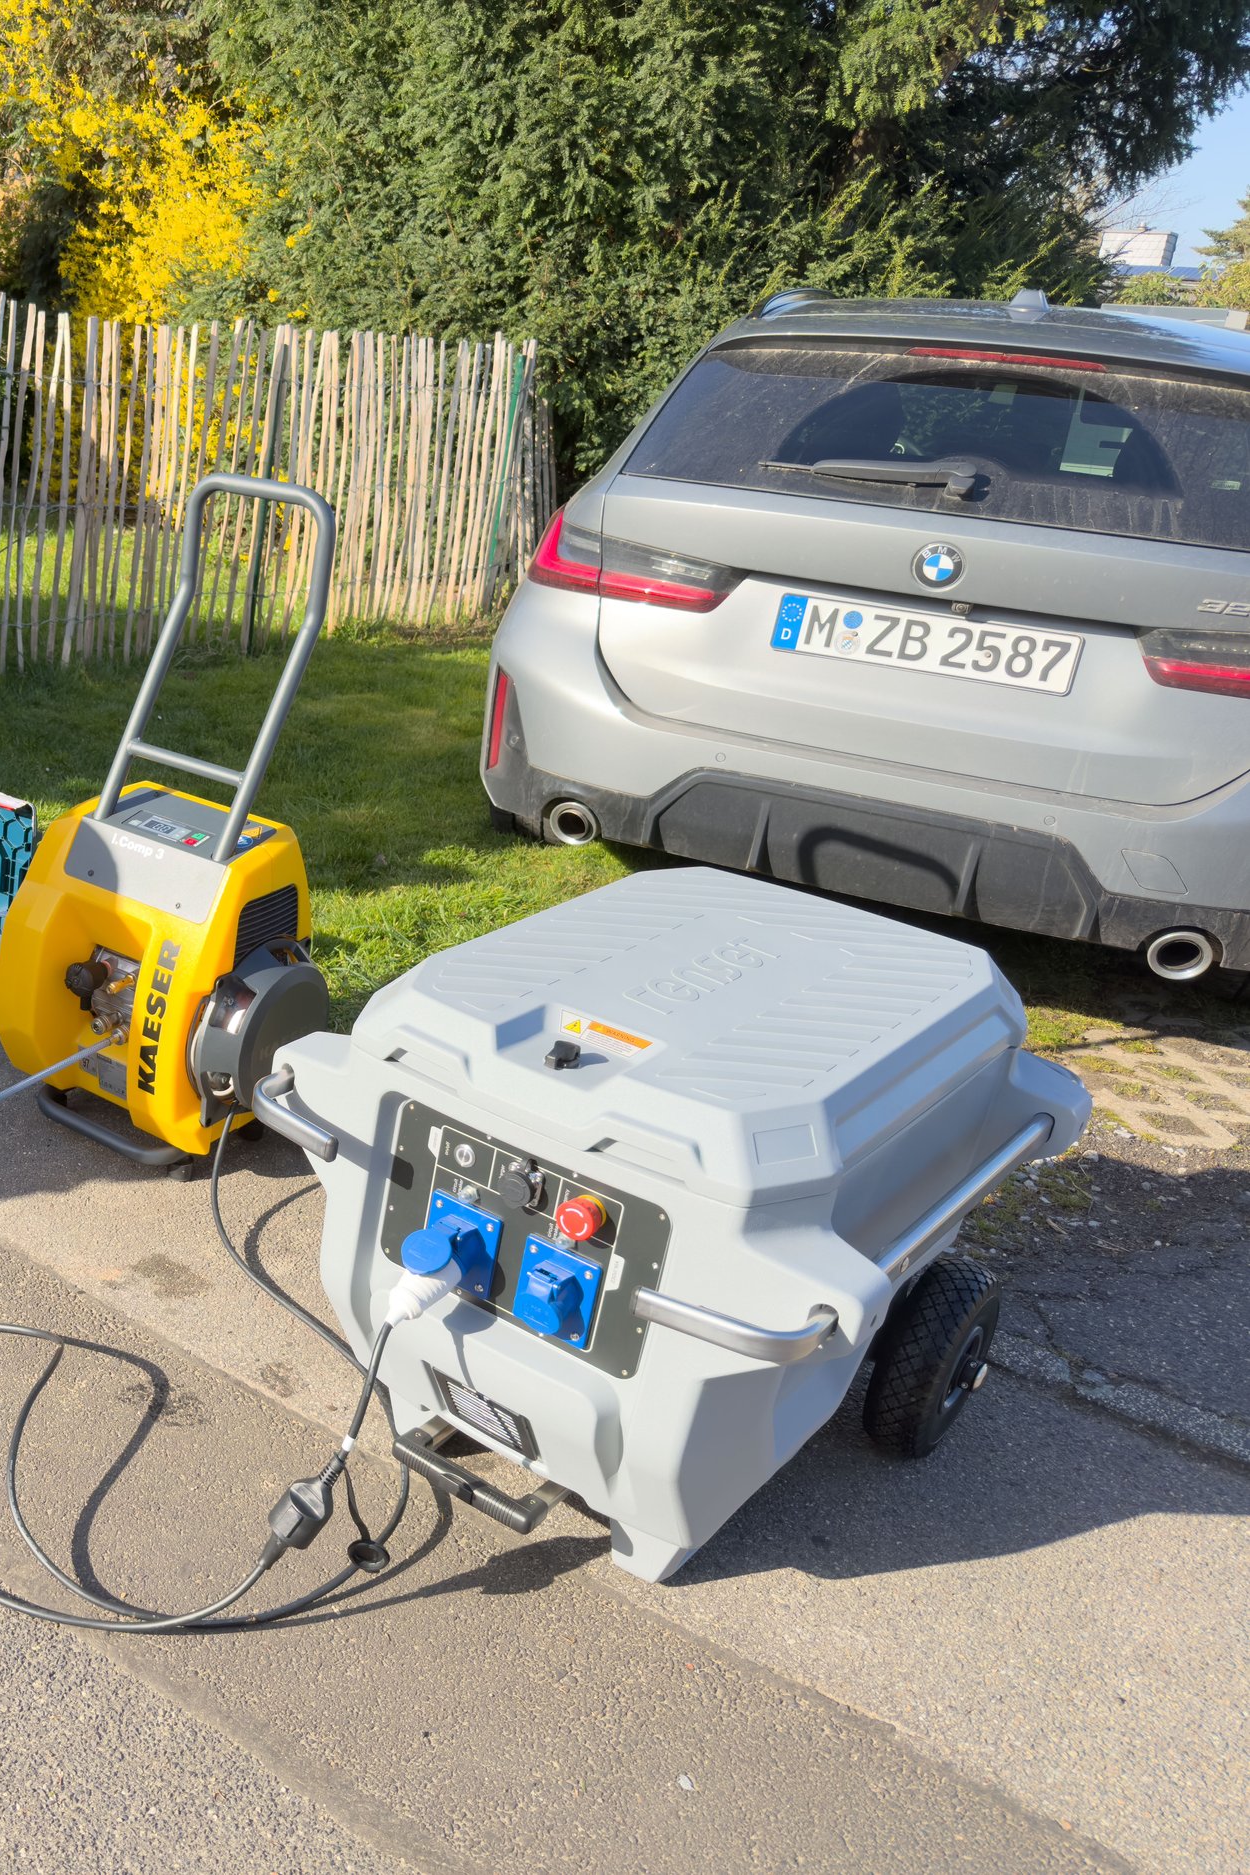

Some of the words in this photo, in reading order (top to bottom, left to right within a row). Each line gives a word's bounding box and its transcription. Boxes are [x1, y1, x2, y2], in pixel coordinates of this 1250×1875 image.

[921, 546, 961, 562] BMW
[780, 628, 792, 640] D
[803, 605, 840, 648] M
[865, 614, 931, 662] ZB
[939, 626, 1072, 682] 2587
[155, 848, 165, 860] 3
[137, 939, 182, 1096] KAESER
